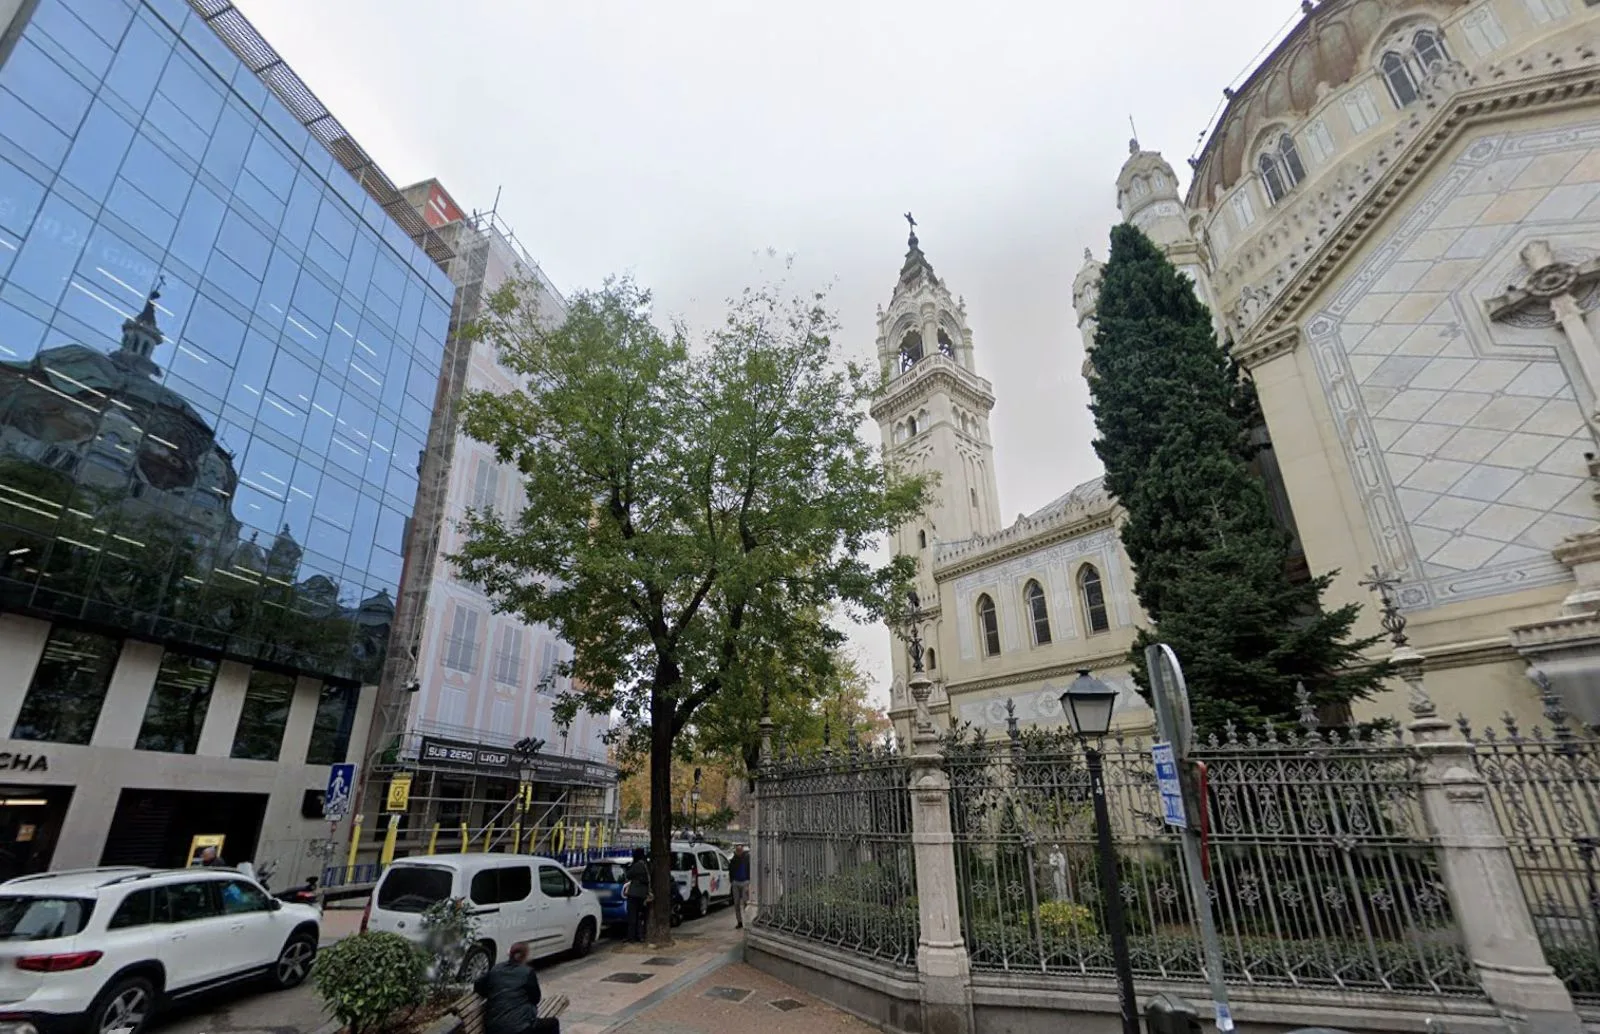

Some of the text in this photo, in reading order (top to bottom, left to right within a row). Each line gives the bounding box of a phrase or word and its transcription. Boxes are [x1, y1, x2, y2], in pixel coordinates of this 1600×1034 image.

[428, 746, 448, 757] SUB
[449, 749, 474, 760] ZERO
[480, 753, 506, 764] WOLF
